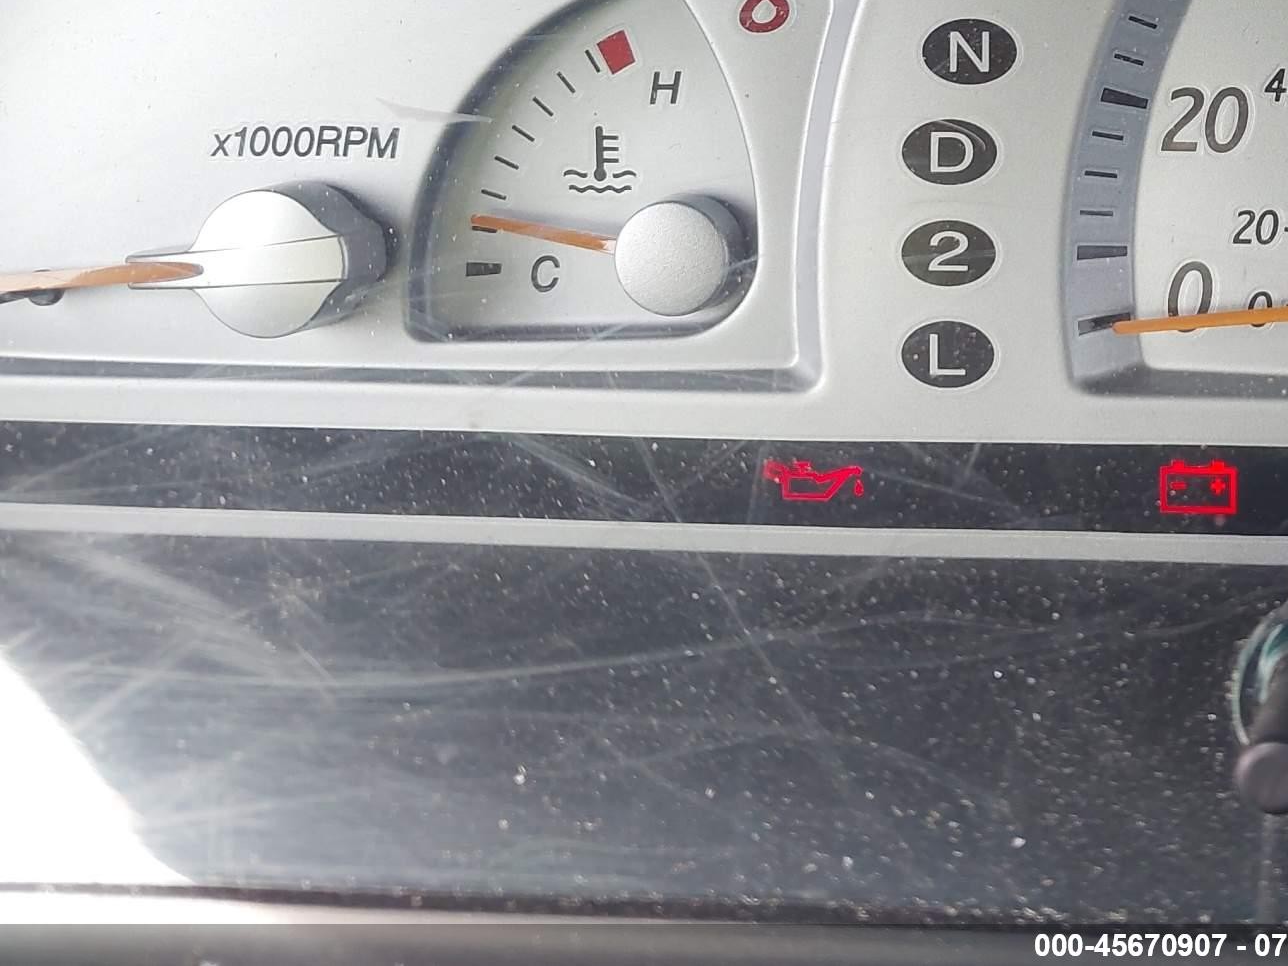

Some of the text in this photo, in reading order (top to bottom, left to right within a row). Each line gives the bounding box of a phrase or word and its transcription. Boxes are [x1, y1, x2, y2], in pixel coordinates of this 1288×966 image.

[949, 32, 989, 75] N
[650, 71, 681, 104] H
[1157, 84, 1248, 153] 20
[211, 126, 399, 158] x1000RPM
[931, 131, 976, 172] D
[1233, 210, 1279, 244] 20
[929, 232, 968, 271] 2
[531, 256, 560, 292] C
[1168, 262, 1213, 332] 0
[930, 334, 965, 376] L
